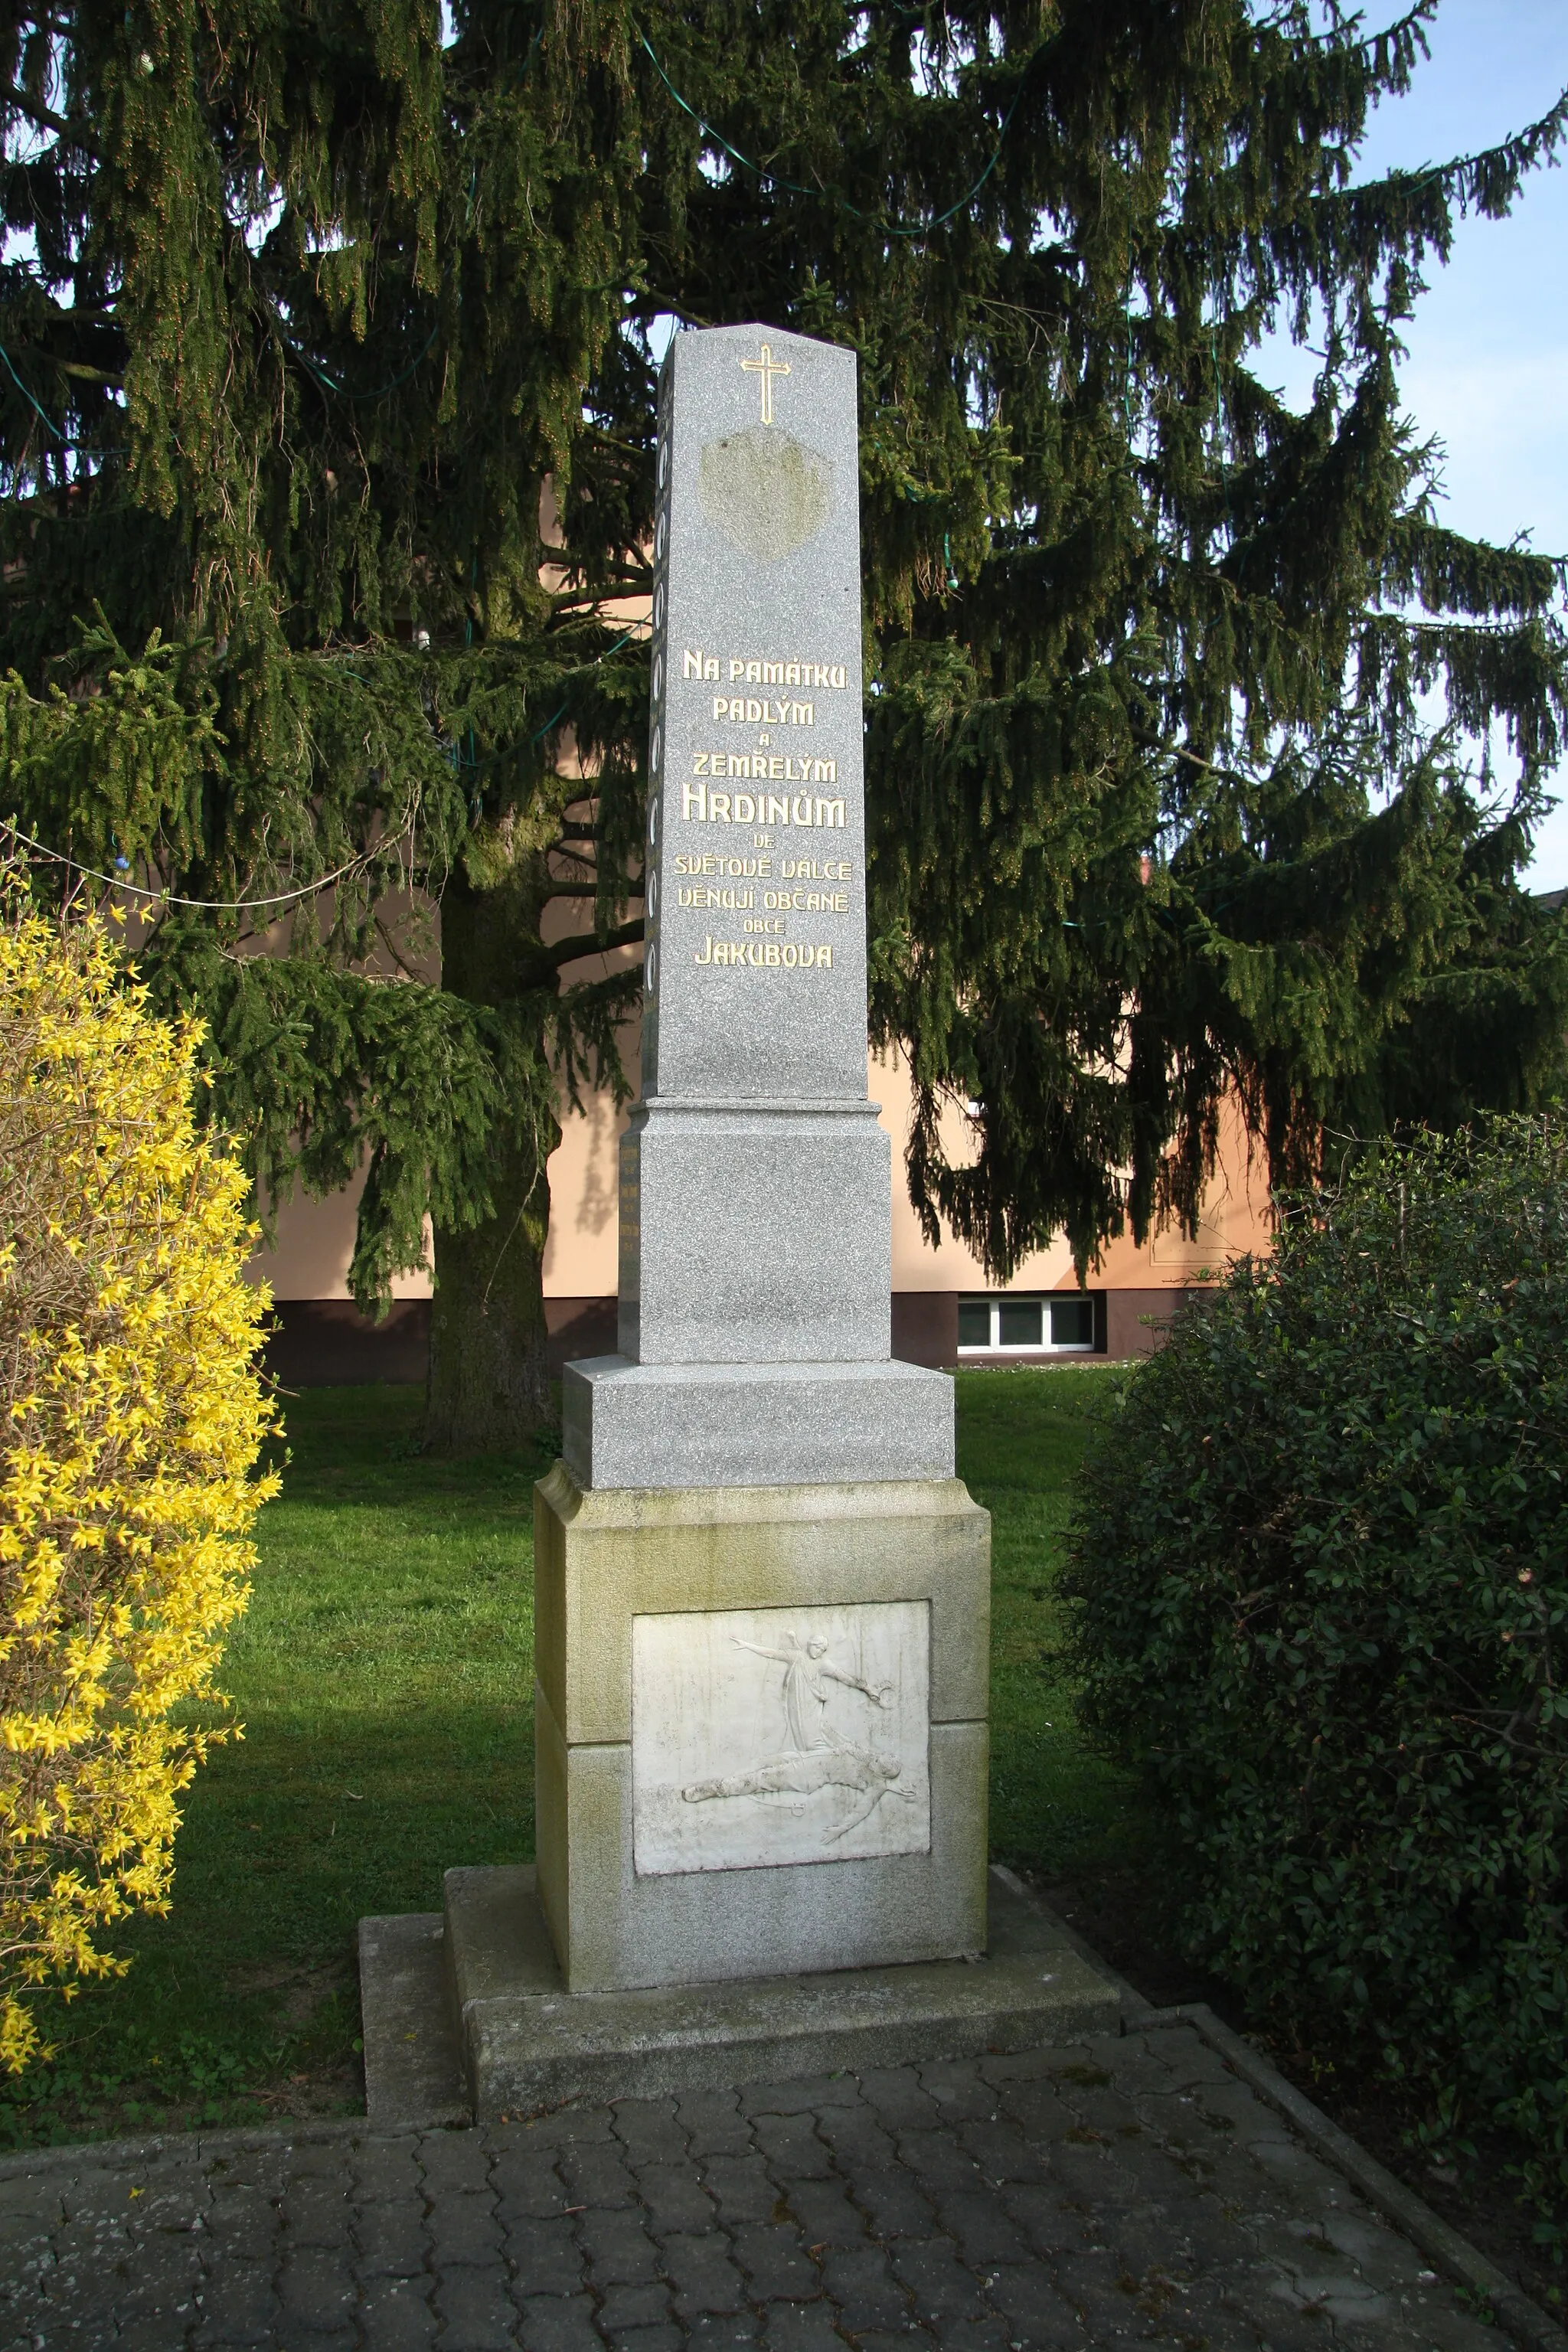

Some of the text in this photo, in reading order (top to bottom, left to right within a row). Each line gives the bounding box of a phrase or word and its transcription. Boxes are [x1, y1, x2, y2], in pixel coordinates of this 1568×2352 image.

[683, 650, 847, 689] NA PAMÁTKU
[713, 694, 815, 726] PADLÝM
[759, 733, 770, 746] A
[693, 750, 837, 782] ZEMŘELÝM
[682, 782, 846, 828] HRDINŮM
[753, 834, 775, 849] VE
[674, 853, 772, 877] SVĚTOVÉ
[782, 856, 852, 880] VÁLCE
[678, 885, 848, 913] VĚNUJÍ OBČANÉ
[743, 920, 786, 934] OBCE
[694, 935, 833, 969] JAKUBOVA
